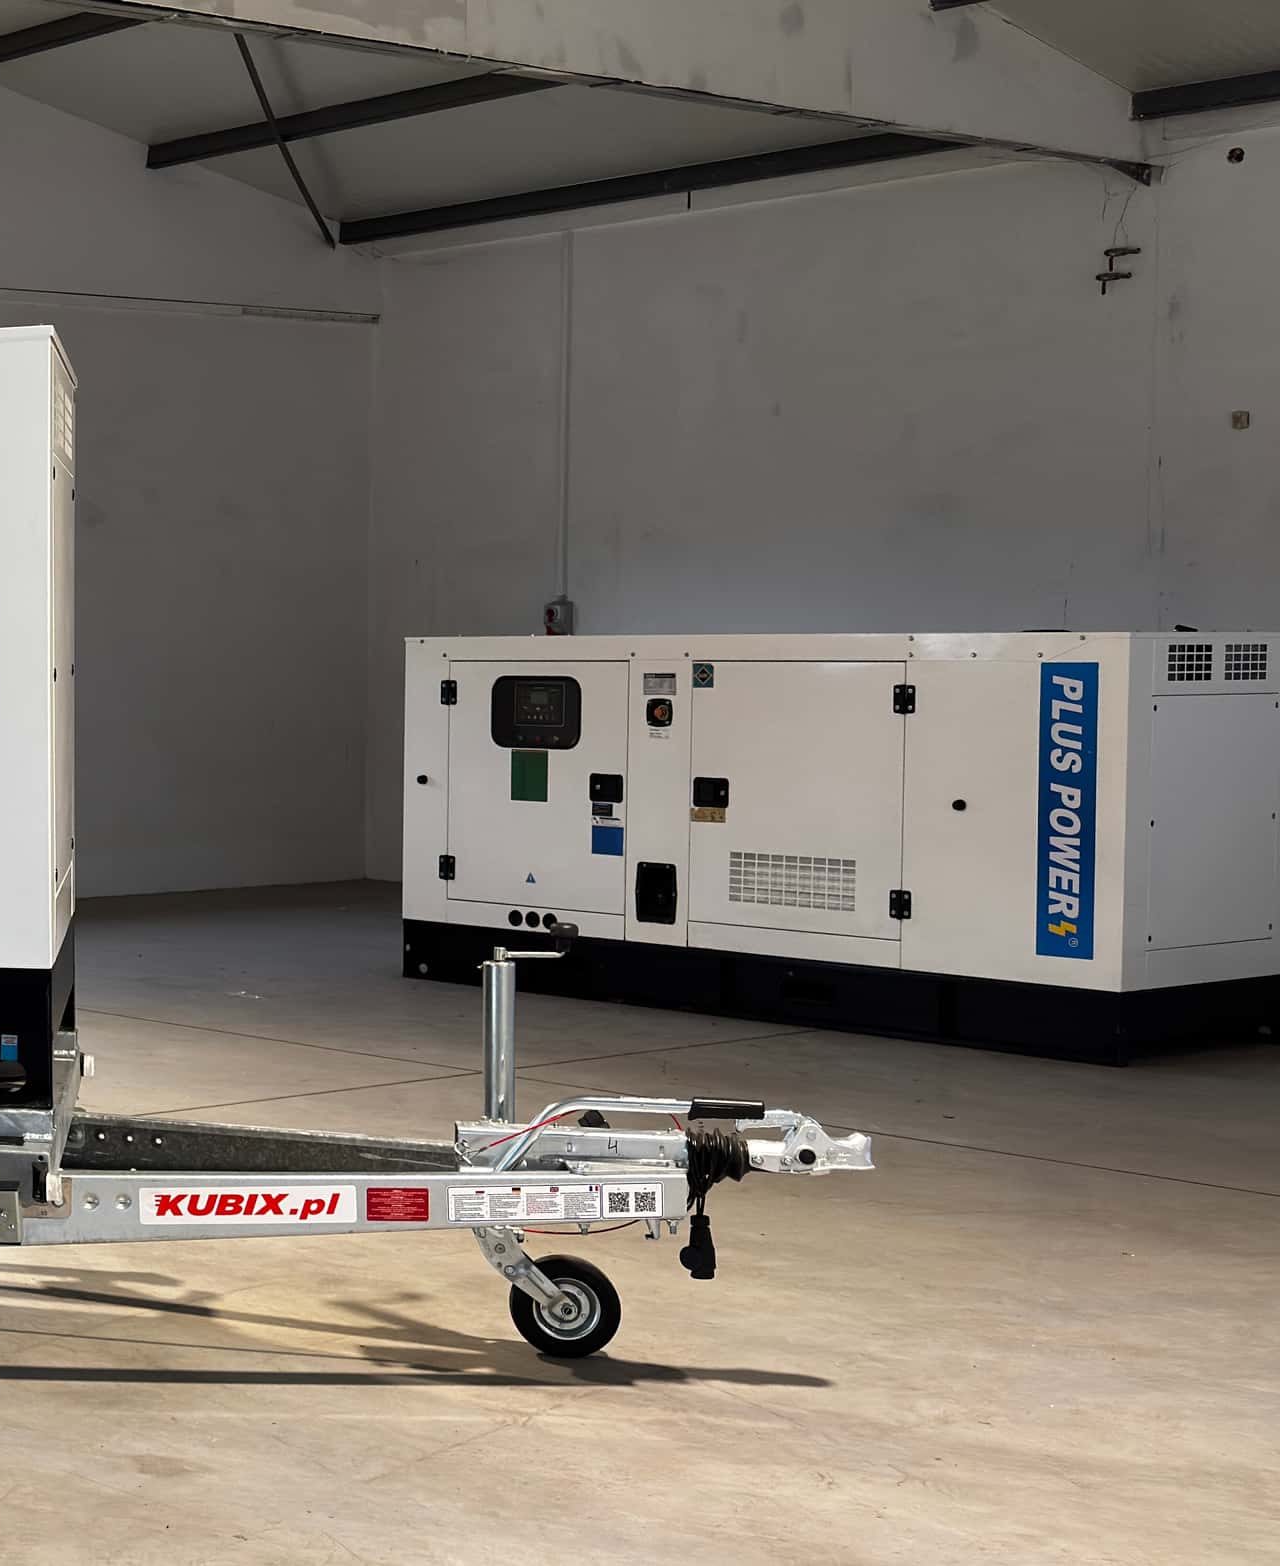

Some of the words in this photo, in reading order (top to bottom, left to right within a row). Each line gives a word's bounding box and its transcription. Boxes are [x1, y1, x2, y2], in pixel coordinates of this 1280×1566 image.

[1050, 675, 1084, 774] PLUS
[1048, 782, 1082, 919] POWER
[154, 1193, 341, 1221] KUBIX.pl
